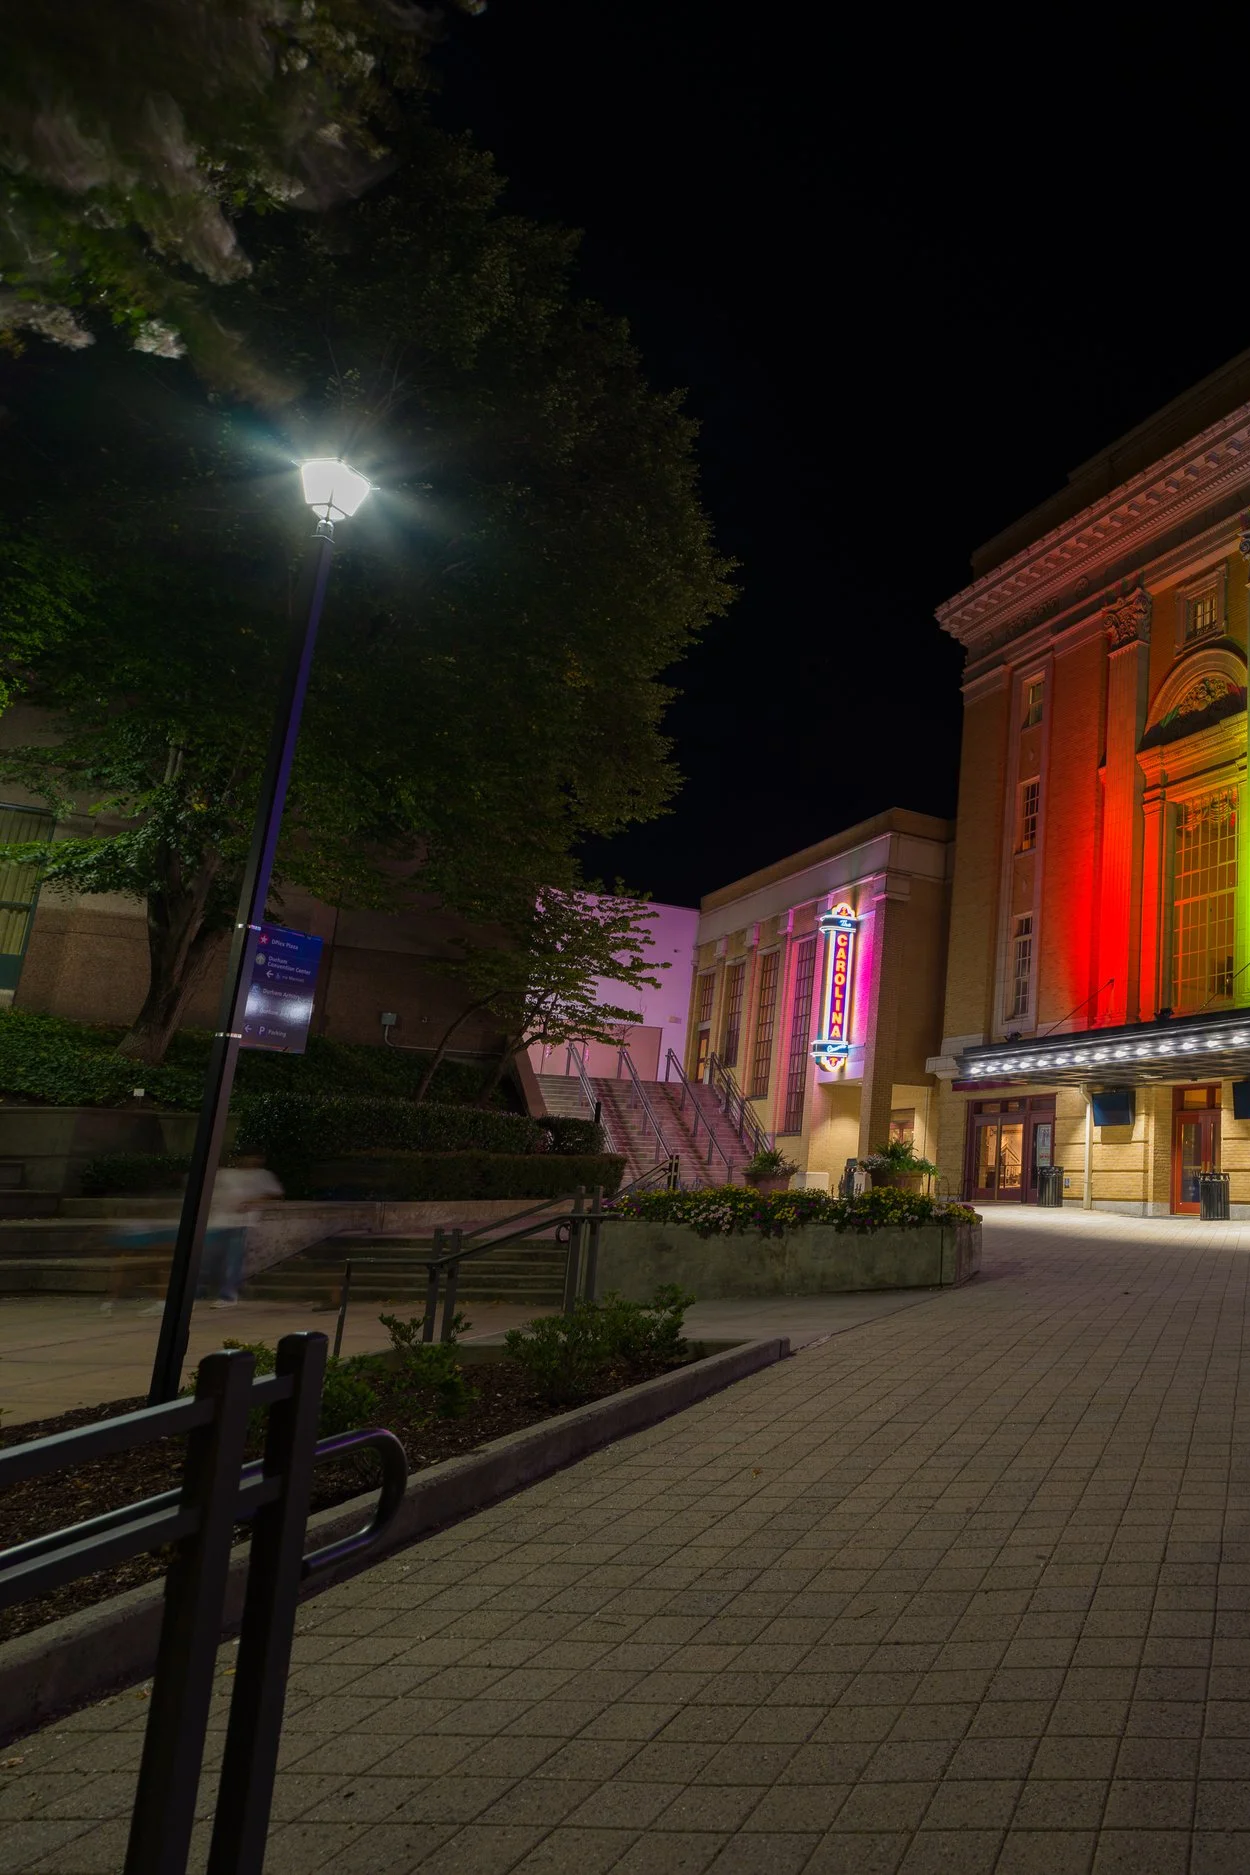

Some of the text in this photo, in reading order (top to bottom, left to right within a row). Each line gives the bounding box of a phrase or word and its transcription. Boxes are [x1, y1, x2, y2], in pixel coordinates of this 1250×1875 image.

[839, 919, 852, 928] The
[285, 942, 299, 950] Plaza
[268, 955, 288, 964] Durham
[267, 961, 311, 975] Convention Center
[831, 934, 848, 1038] CAROLINA
[262, 989, 282, 997] Durham
[268, 1030, 287, 1038] Parking
